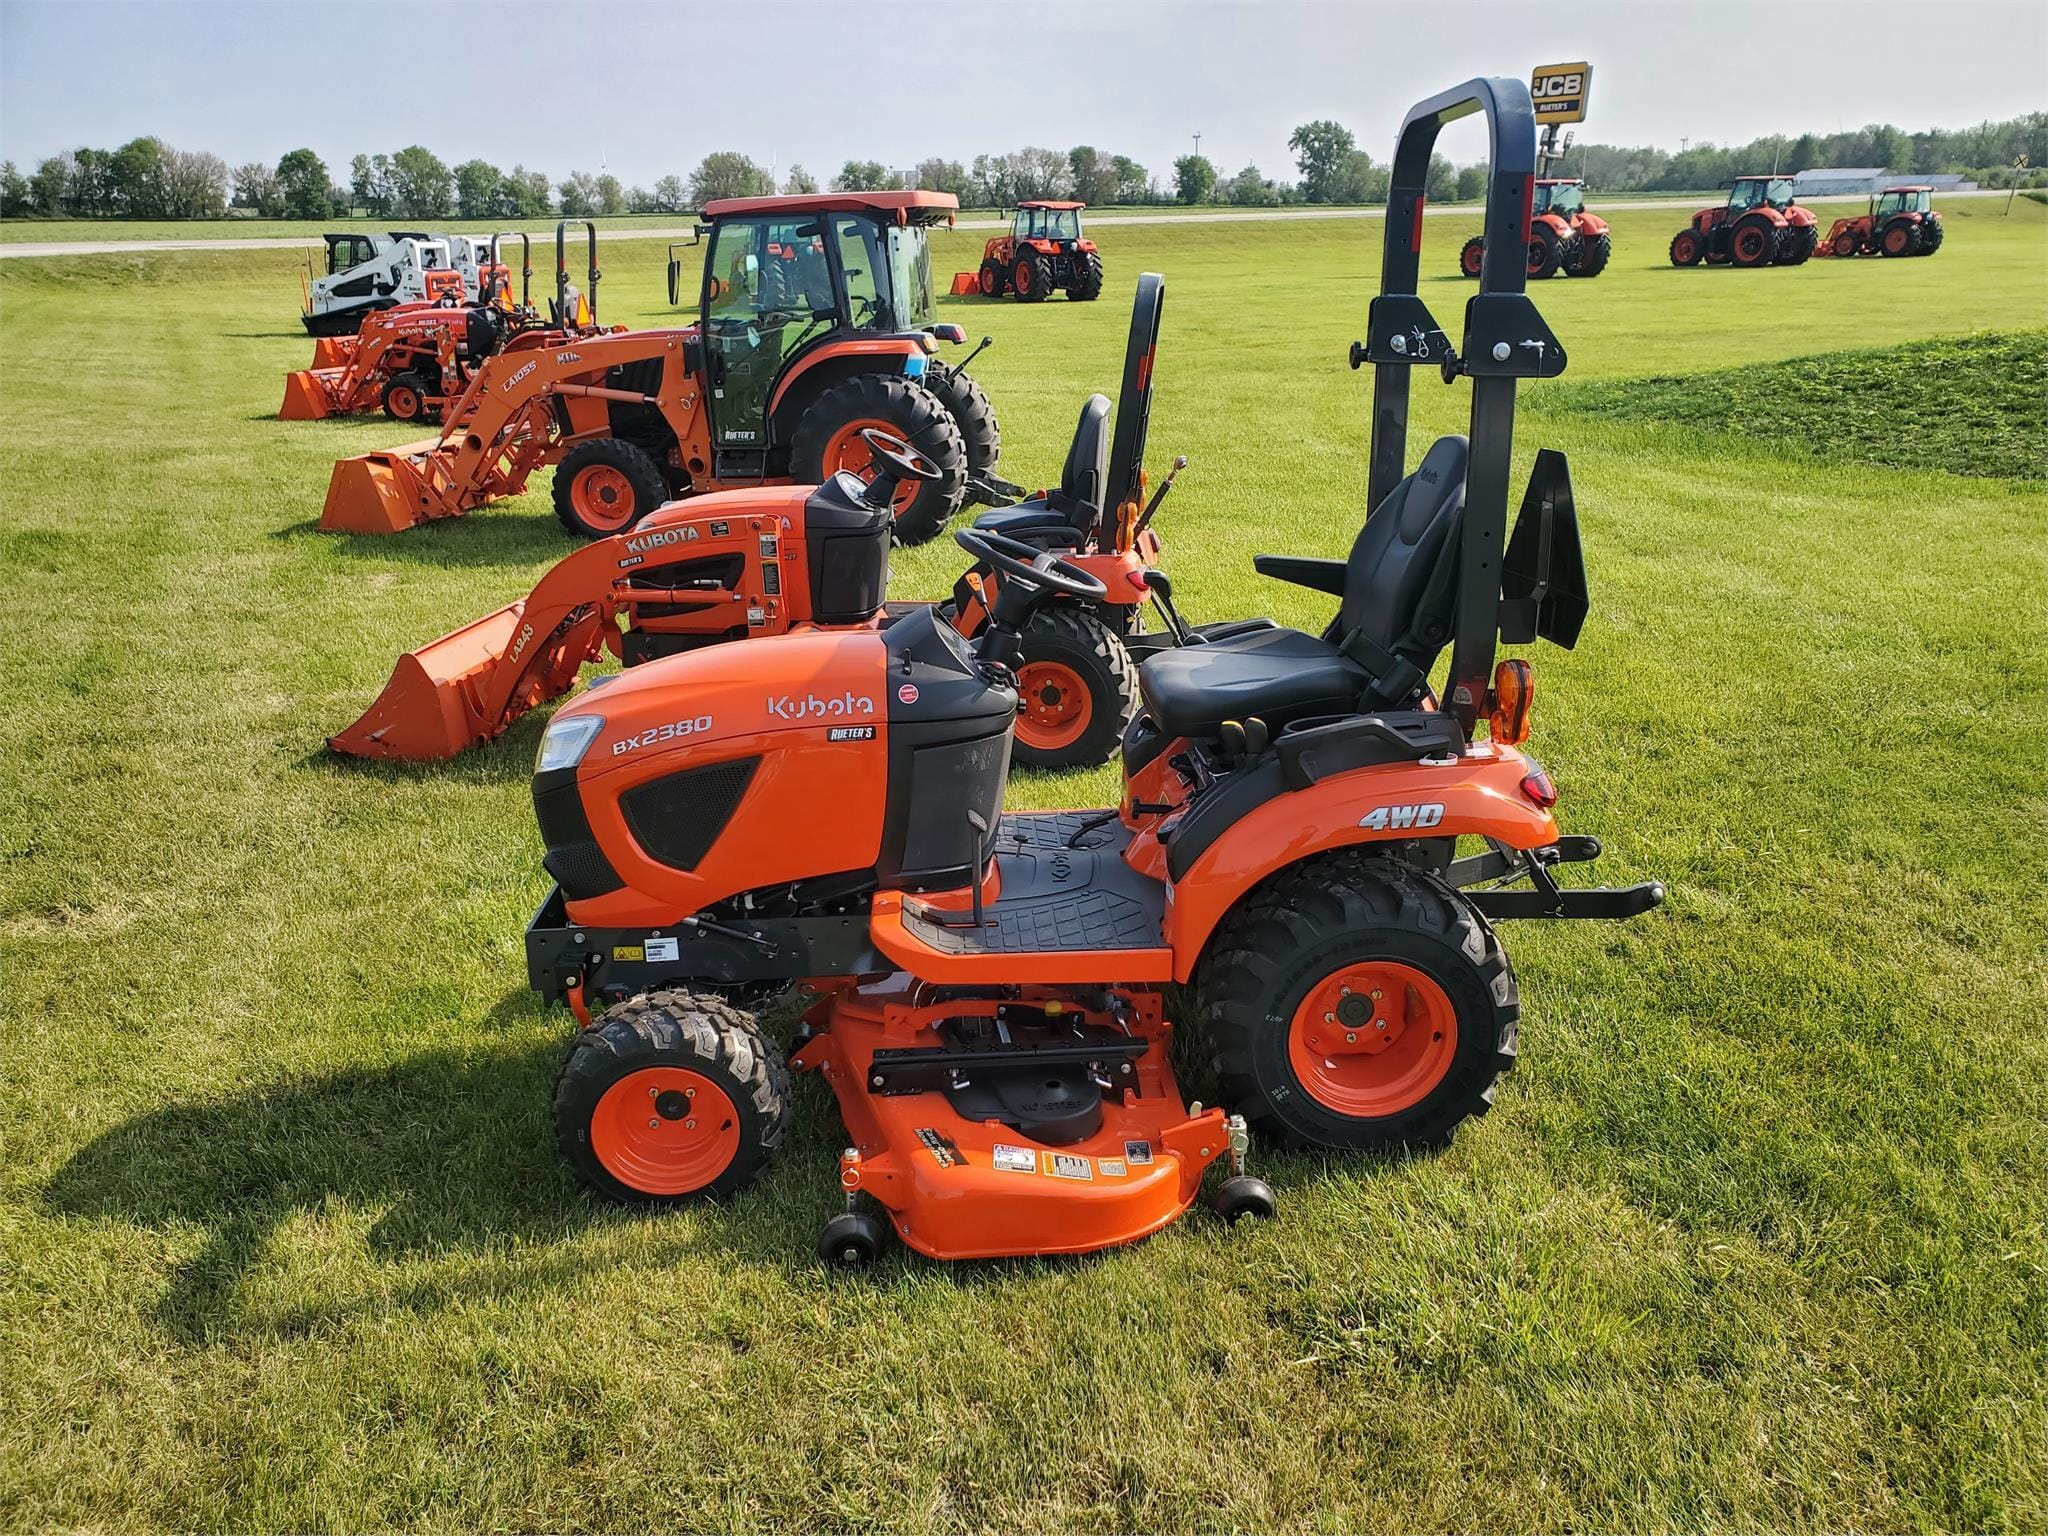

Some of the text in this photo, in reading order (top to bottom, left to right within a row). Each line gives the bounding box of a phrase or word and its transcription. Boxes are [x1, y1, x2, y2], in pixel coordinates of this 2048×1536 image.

[1532, 74, 1582, 97] JCB
[502, 360, 537, 393] LA1055
[626, 526, 700, 554] KUBOTA
[767, 691, 874, 719] Kubota
[612, 715, 713, 756] BX2380
[831, 727, 873, 740] RUETER'S
[1358, 803, 1445, 831] 4WD
